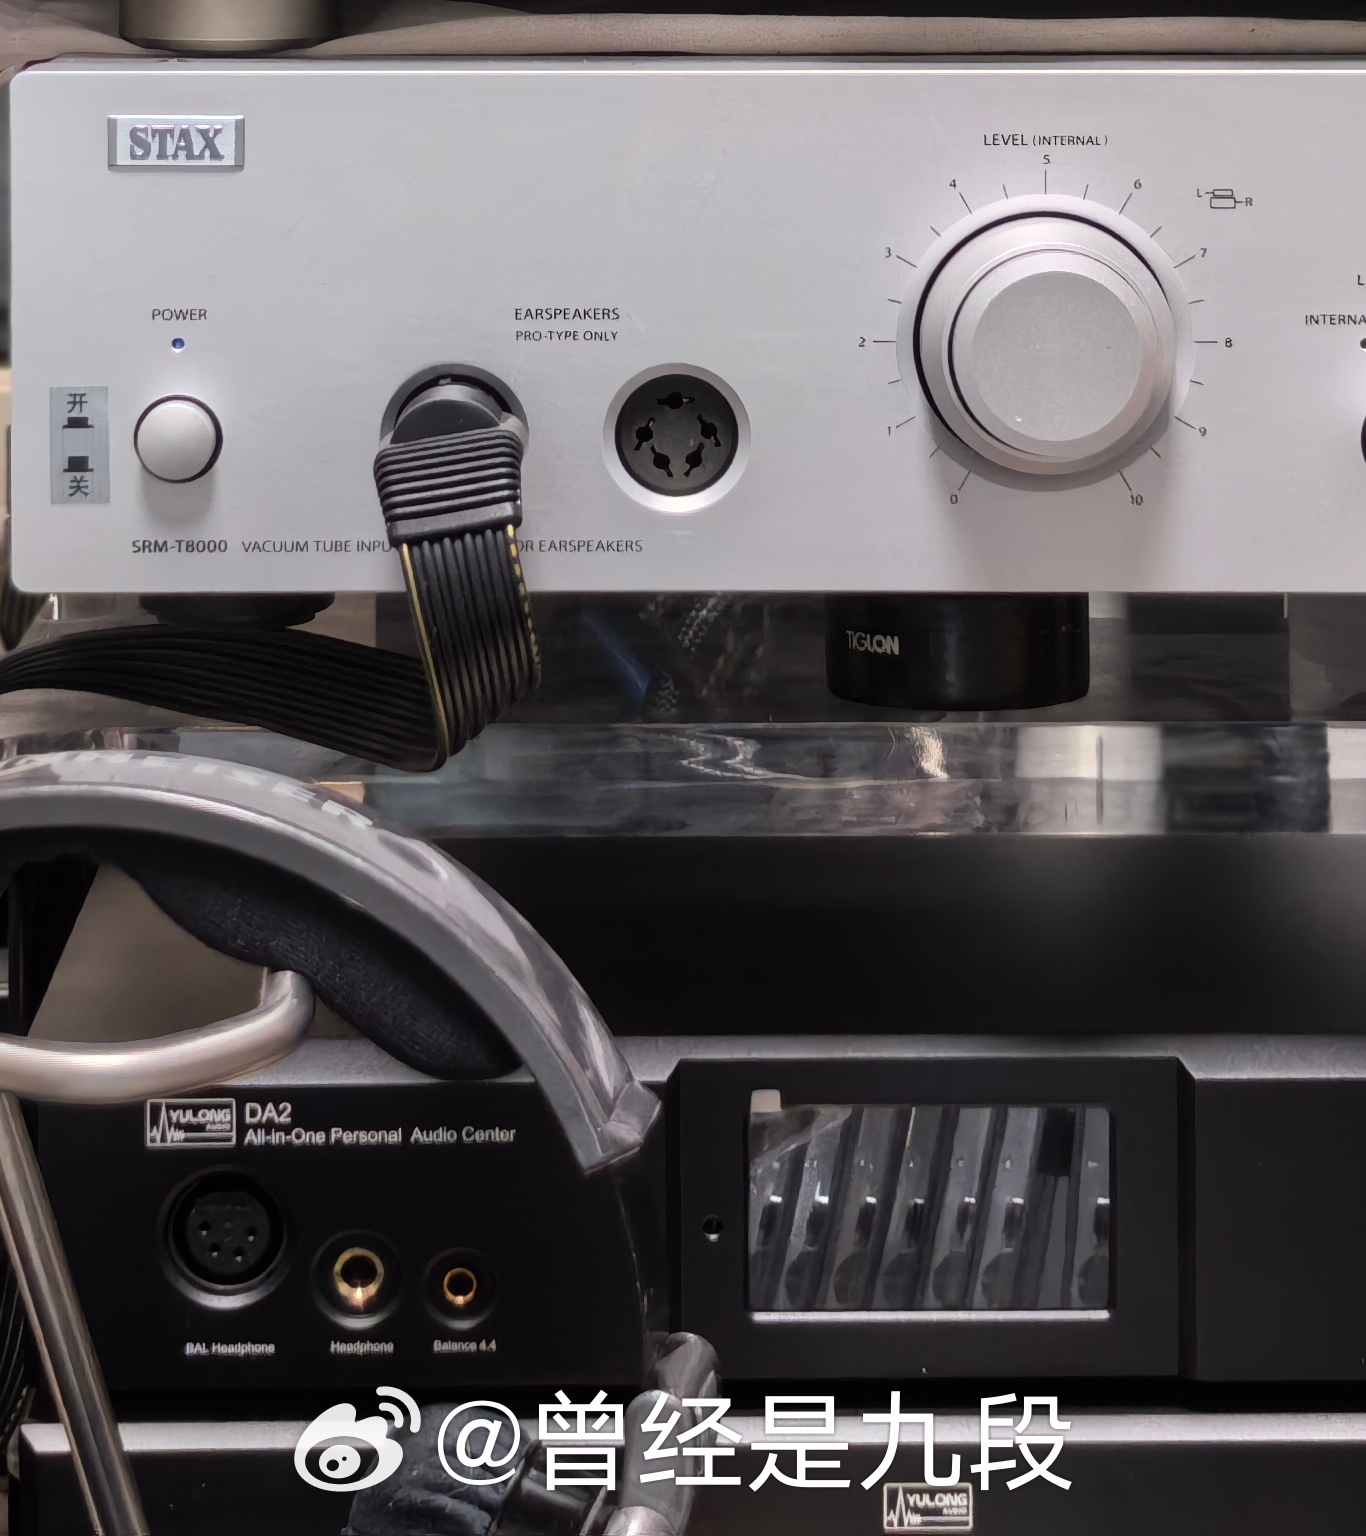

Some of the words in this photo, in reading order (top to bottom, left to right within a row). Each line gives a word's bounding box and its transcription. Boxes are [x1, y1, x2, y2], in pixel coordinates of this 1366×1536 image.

[129, 126, 225, 161] STAX
[983, 133, 1029, 146] LEVEL
[1042, 154, 1051, 165] 5
[948, 178, 957, 190] 4
[1133, 178, 1142, 190] 6
[1196, 187, 1203, 199] L
[1244, 196, 1253, 207] R
[884, 246, 893, 259] 3
[1199, 247, 1208, 259] 7
[151, 308, 208, 322] POWER
[514, 307, 620, 321] EARSPEAKERS
[515, 330, 580, 342] PRO-TYPE
[582, 330, 618, 342] ONLY
[858, 336, 867, 348] 2
[1224, 337, 1233, 349] 8
[66, 392, 88, 414] 开
[1198, 426, 1208, 437] 9
[67, 475, 91, 498] 关
[949, 493, 959, 505] 0
[131, 539, 228, 554] SRM-T8000
[241, 540, 309, 553] VACUUM
[312, 539, 352, 553] TUBE
[356, 539, 392, 553] INPU
[538, 539, 643, 553] EARSPEAKERS
[846, 629, 900, 656] TIGLON
[170, 1108, 231, 1123] YULONG
[245, 1101, 292, 1125] DA2
[244, 1127, 326, 1146] All-in-One
[329, 1127, 402, 1145] Personal
[409, 1126, 458, 1143] Audio
[461, 1125, 516, 1143] Center
[185, 1342, 209, 1356] BAL
[211, 1341, 276, 1357] Headphone
[330, 1340, 394, 1355] Headphone
[433, 1339, 478, 1353] Balance
[478, 1339, 497, 1352] 4.4
[907, 1493, 968, 1507] YULONG
